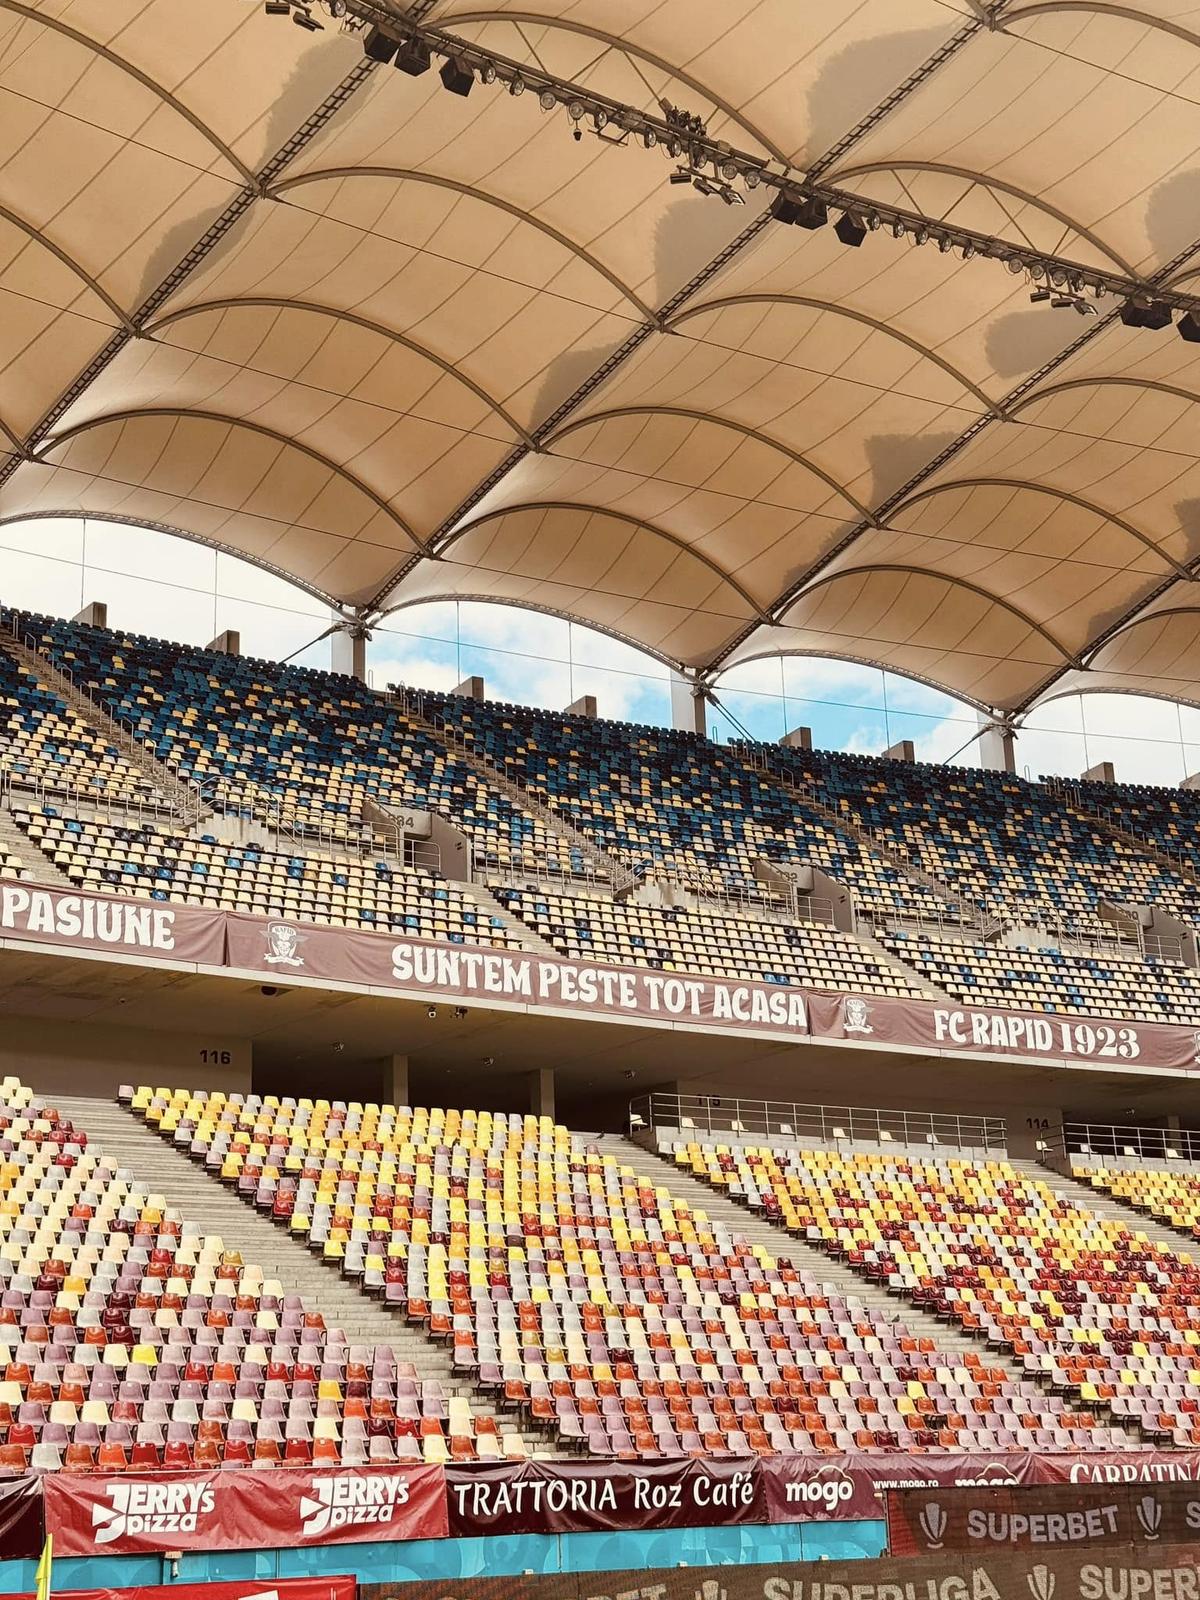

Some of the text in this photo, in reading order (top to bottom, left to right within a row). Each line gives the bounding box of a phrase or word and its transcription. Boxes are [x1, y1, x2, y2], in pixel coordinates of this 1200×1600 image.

[387, 814, 415, 829] 34
[2, 887, 175, 950] PASIUNE
[391, 944, 808, 1027] SUNTEM PESTE TOT ACASA
[933, 1009, 1141, 1058] FC RAPID 1923
[200, 1049, 231, 1065] 116
[1026, 1117, 1049, 1129] 114
[1069, 1463, 1200, 1484] CARPATIN
[454, 1472, 754, 1517] TRATTORIA Roz Café
[785, 1478, 854, 1511] mogo
[127, 1513, 198, 1537] pizza
[330, 1502, 393, 1525] pizza
[967, 1505, 1119, 1542] SUPERBET
[1080, 1564, 1200, 1600] SUPER
